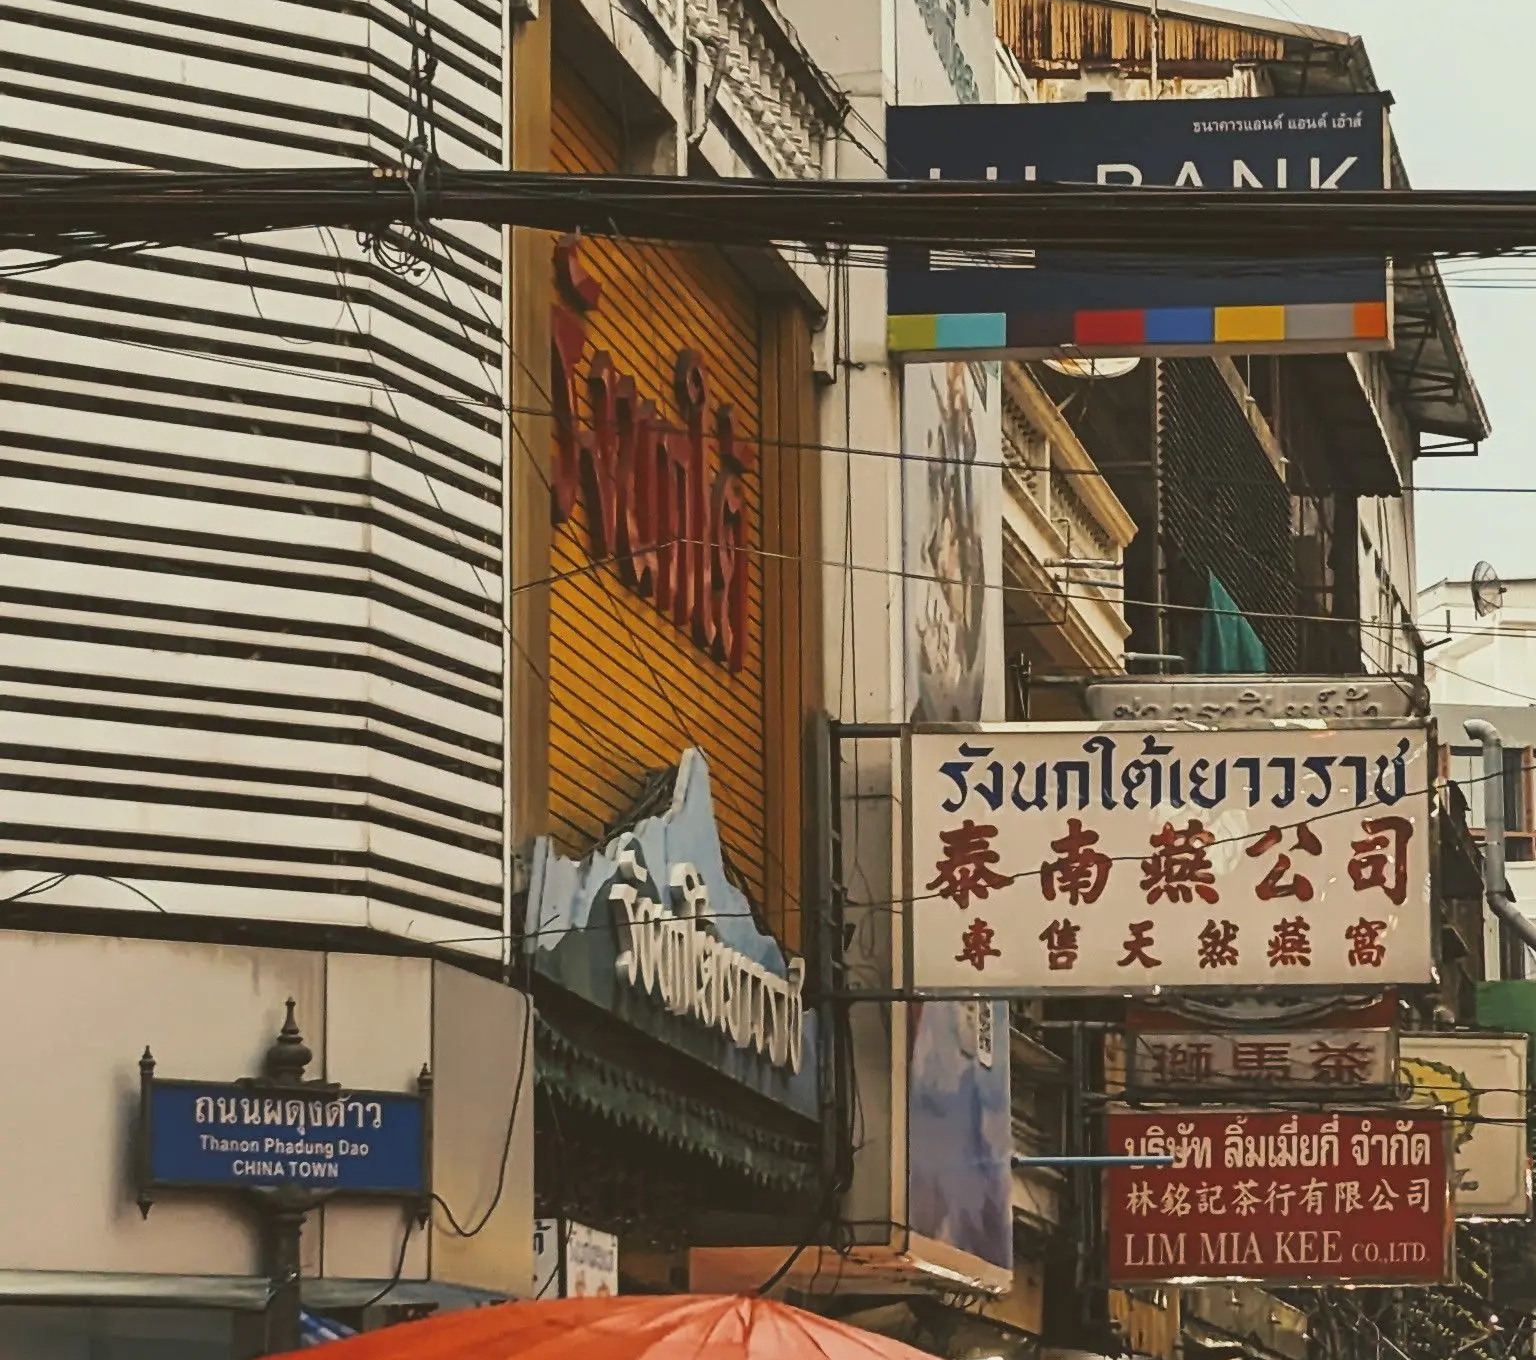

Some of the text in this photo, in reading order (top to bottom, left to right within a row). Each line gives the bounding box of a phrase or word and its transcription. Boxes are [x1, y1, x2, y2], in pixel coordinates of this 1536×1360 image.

[925, 815, 1414, 907] 泰南燕公司
[194, 1094, 382, 1135] ถนนผดุงด้าว
[201, 1135, 369, 1159] Thanon Phadung Dao
[1351, 1120, 1431, 1166] จำกัด
[232, 1159, 339, 1178] CHINA TOWN
[1126, 1177, 1431, 1217] 林銘記茶行有限公司
[1125, 1232, 1187, 1266] LIM
[1200, 1232, 1264, 1265] MIA
[1275, 1230, 1343, 1264] KEE
